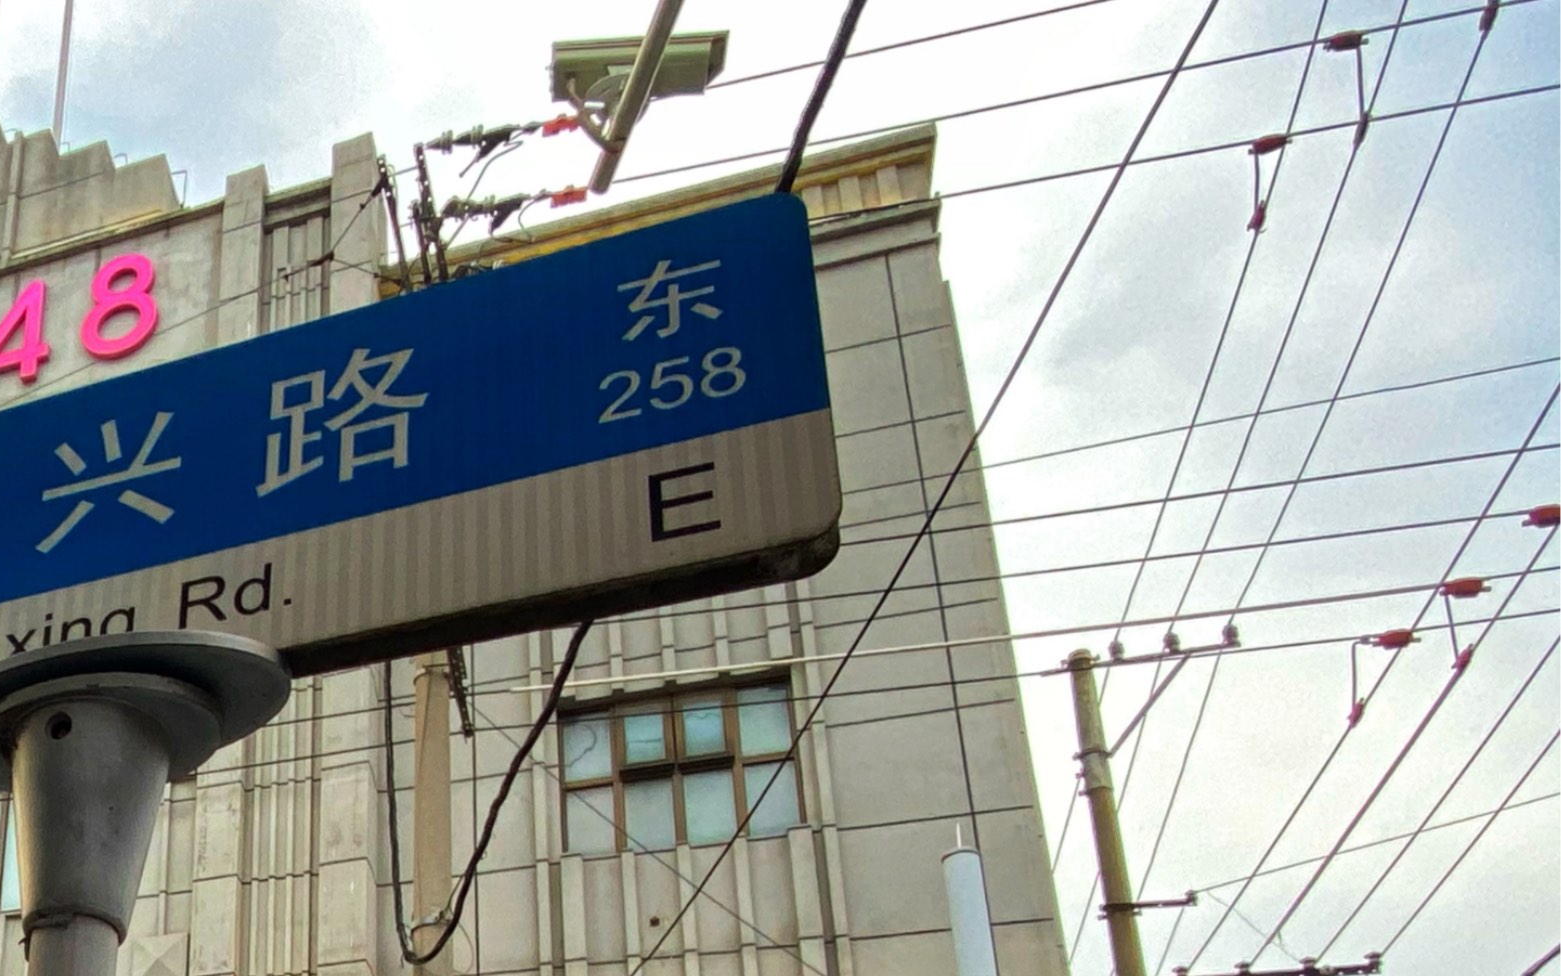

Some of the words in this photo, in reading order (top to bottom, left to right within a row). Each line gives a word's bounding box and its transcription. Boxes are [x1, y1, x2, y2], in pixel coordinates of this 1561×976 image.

[617, 259, 724, 342] 东
[597, 346, 747, 424] 258
[647, 462, 722, 543] E
[177, 562, 293, 630] Rd.
